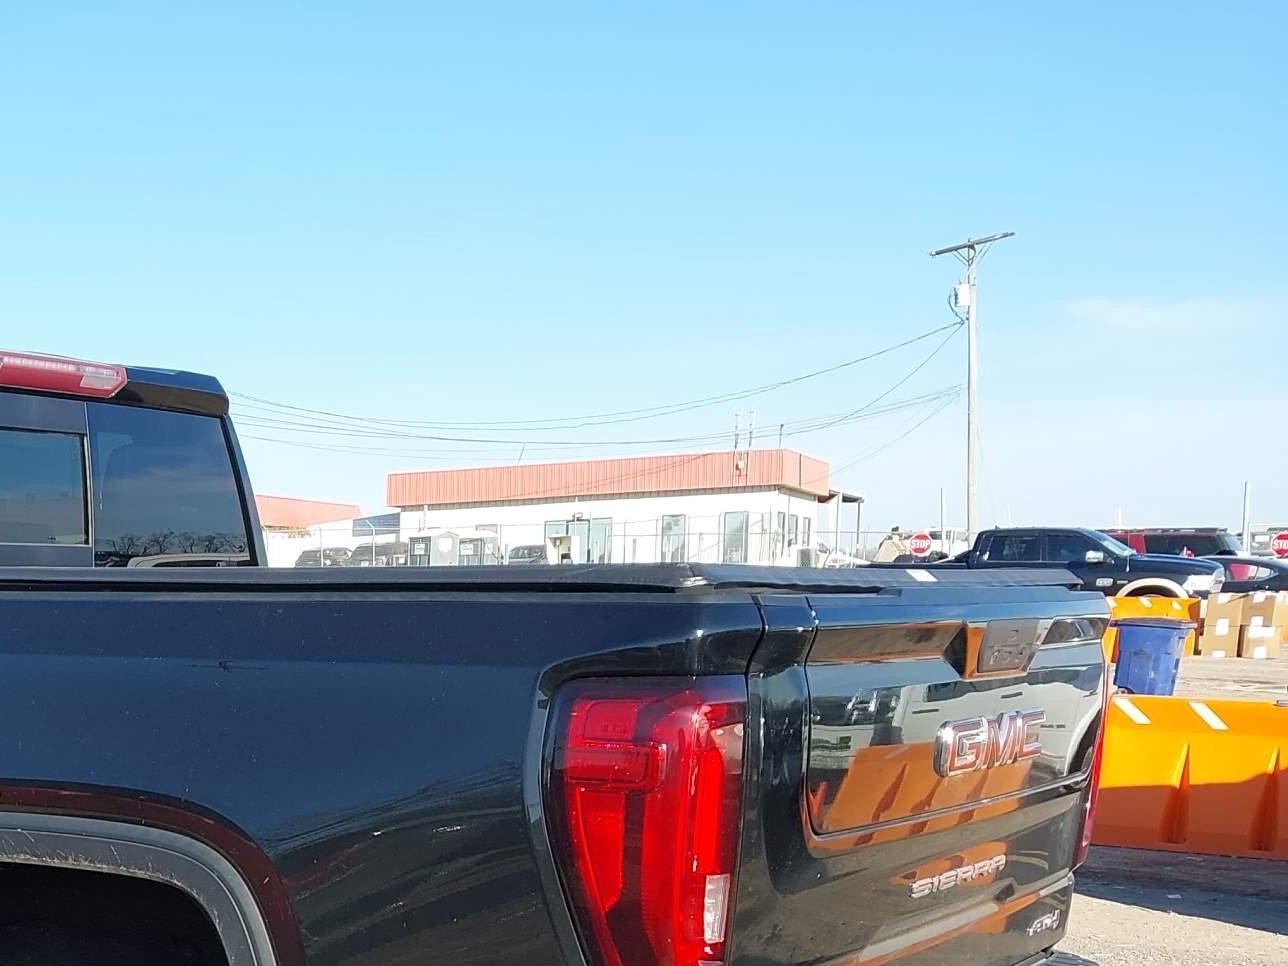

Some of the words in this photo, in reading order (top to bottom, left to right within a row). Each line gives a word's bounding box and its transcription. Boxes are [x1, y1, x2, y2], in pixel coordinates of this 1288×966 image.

[911, 540, 931, 550] STOP
[1272, 540, 1288, 550] STO
[933, 709, 1046, 777] GMC
[909, 855, 1006, 898] SIERRA
